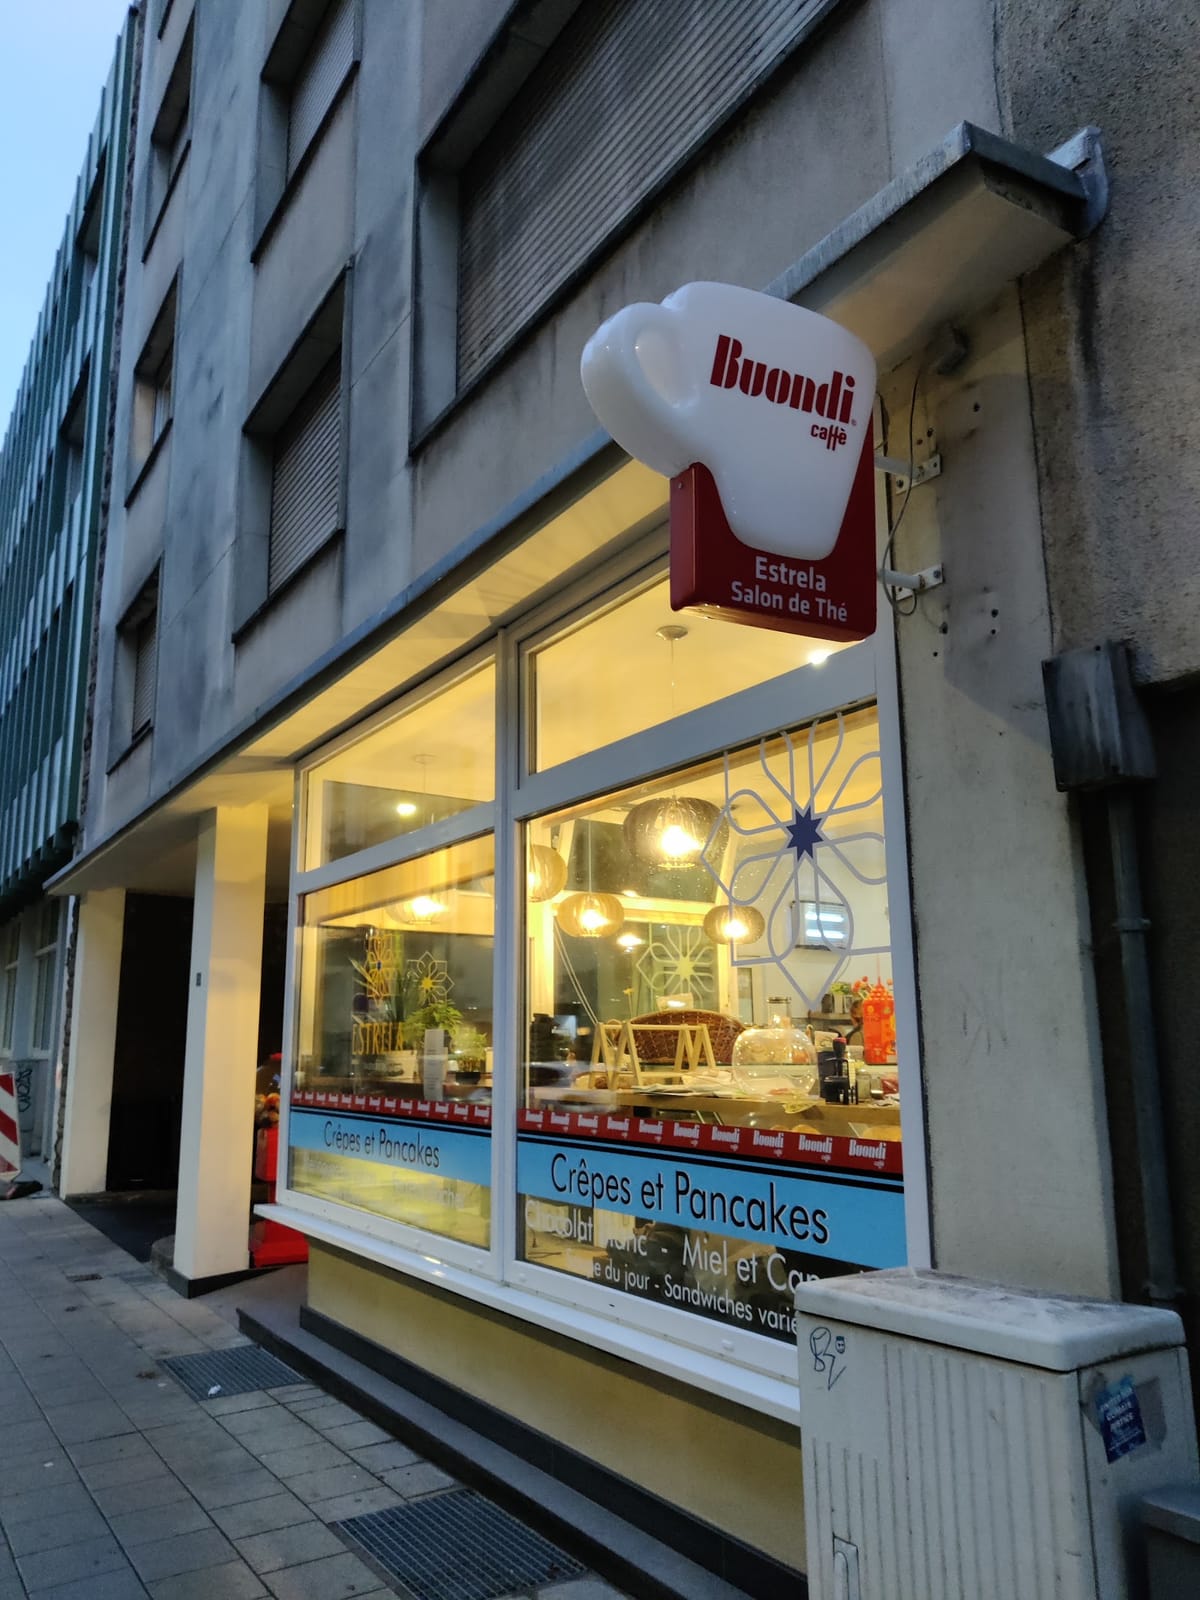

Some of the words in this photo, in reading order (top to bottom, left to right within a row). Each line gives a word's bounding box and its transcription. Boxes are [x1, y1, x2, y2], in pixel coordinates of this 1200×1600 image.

[710, 334, 855, 424] Buondi
[810, 424, 848, 452] caffè
[755, 555, 826, 592] Estrela
[731, 581, 783, 609] Salon
[788, 593, 810, 615] de
[815, 598, 848, 622] Thé
[364, 1131, 375, 1155] et
[379, 1128, 440, 1168] Pancakes
[848, 1139, 887, 1160] Buondi
[551, 1153, 632, 1208] Crêpes
[641, 1173, 664, 1211] et
[676, 1170, 828, 1244] Pancakes
[682, 1234, 728, 1277] Miel
[737, 1253, 757, 1284] et
[605, 1258, 620, 1282] du
[624, 1263, 650, 1291] jour
[664, 1274, 753, 1321] Sandwiches
